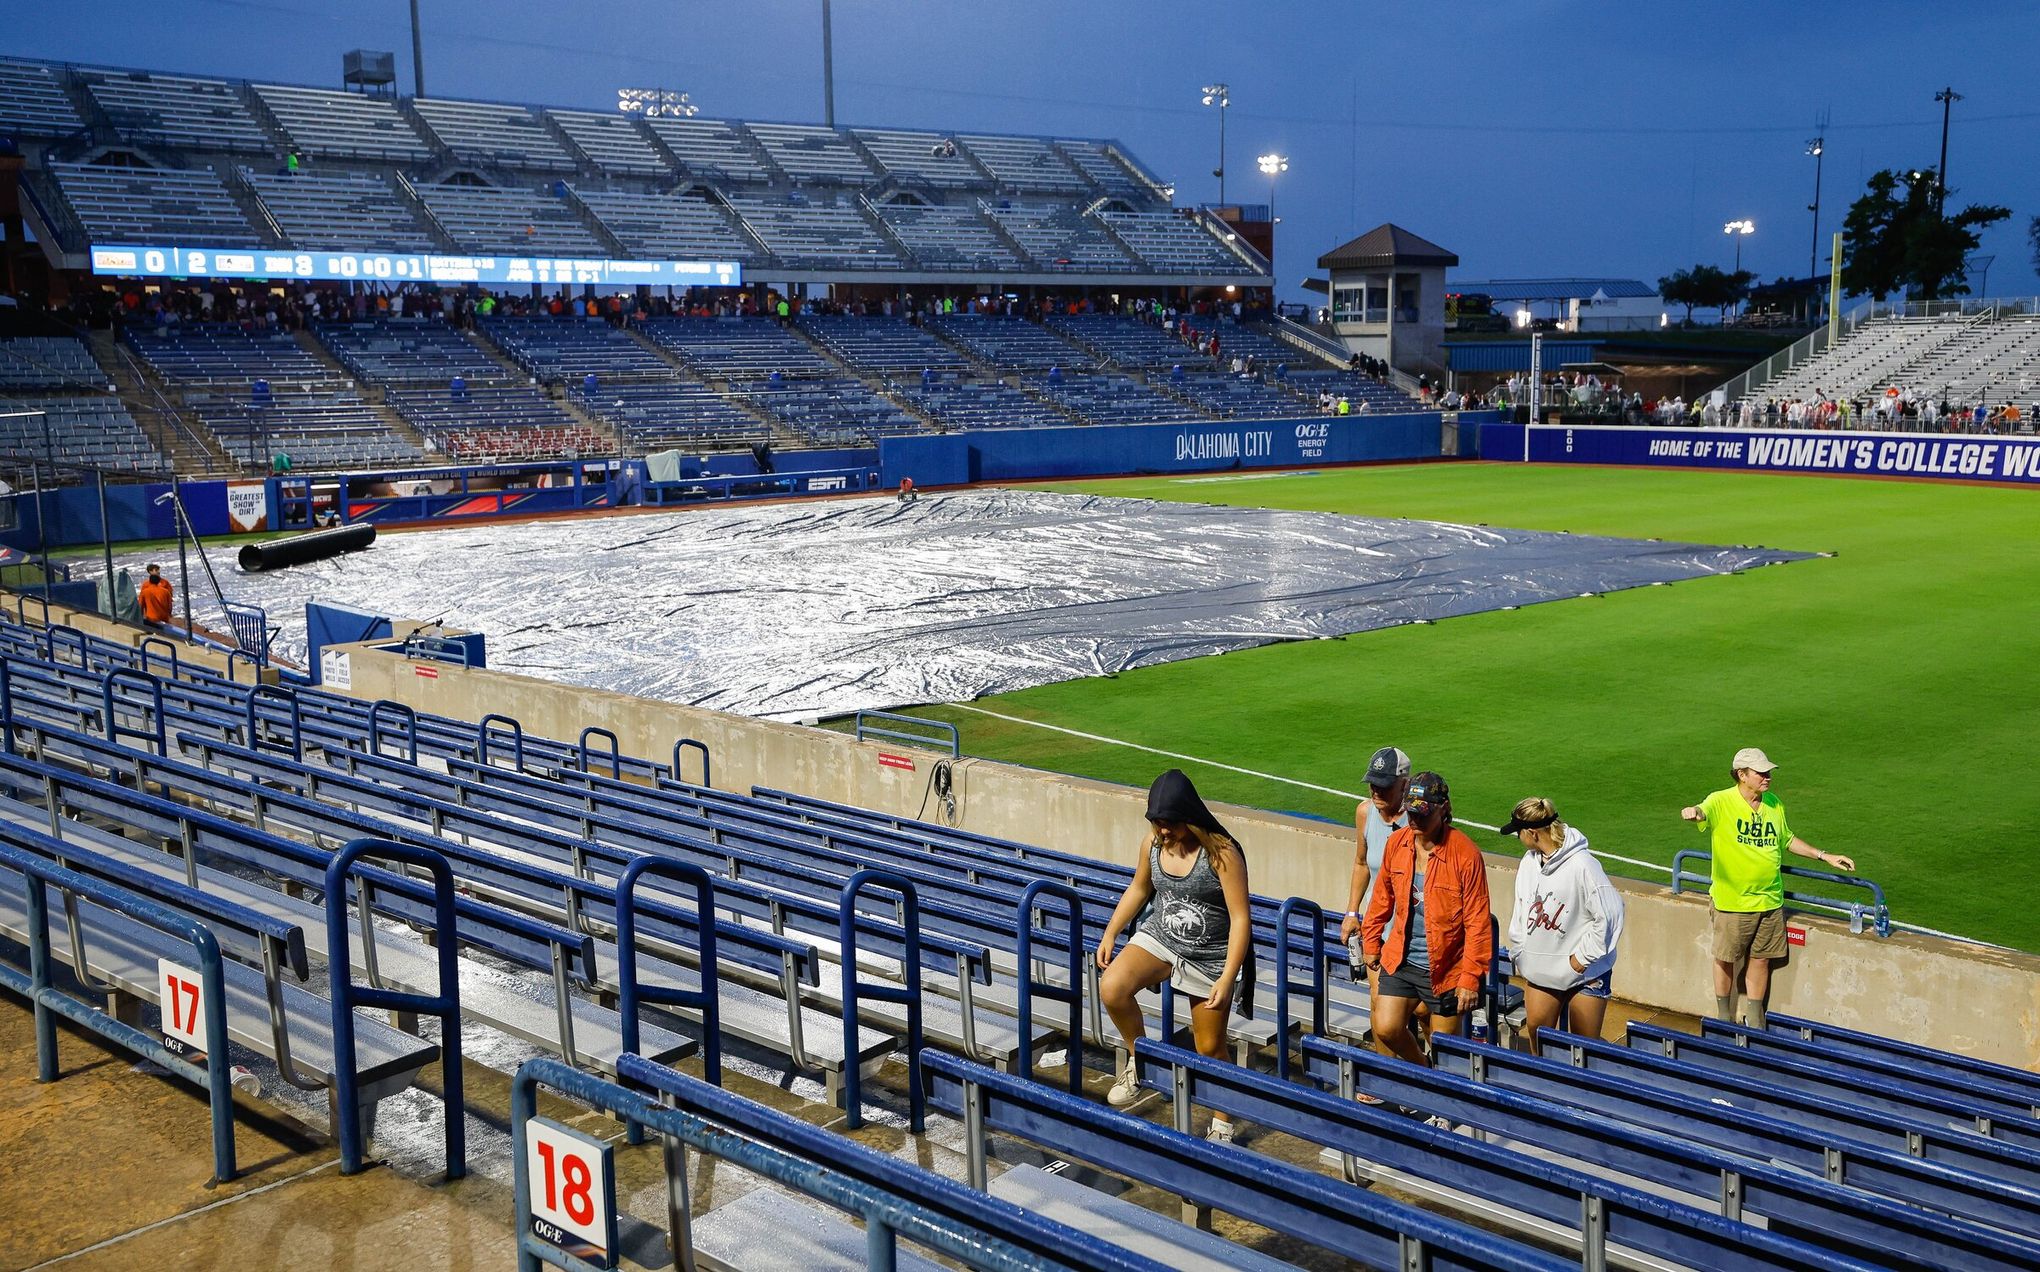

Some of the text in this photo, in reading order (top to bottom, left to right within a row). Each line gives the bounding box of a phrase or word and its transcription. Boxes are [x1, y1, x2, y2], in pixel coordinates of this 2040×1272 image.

[145, 251, 165, 273] 0
[188, 252, 207, 273] 2
[341, 256, 357, 277] 0
[375, 257, 391, 277] 0
[409, 258, 422, 278] 1
[1176, 428, 1273, 461] OKLAHOMA CITY
[1298, 439, 1327, 448] ENERGY
[1302, 449, 1323, 457] FIELD
[1649, 440, 1691, 457] HOME
[1693, 441, 1713, 458] OF
[1716, 442, 1743, 459] THE
[1748, 437, 1875, 469] WOMEN'S
[1877, 441, 1999, 475] COLLEGE
[807, 476, 847, 491] ESPN
[229, 492, 264, 502] GREATEST
[233, 500, 255, 509] SHOW
[238, 508, 255, 516] DIRT
[1736, 818, 1778, 838] USA
[1737, 834, 1776, 848] SOFTBALL
[167, 974, 199, 1036] 17
[537, 1140, 595, 1227] 18
